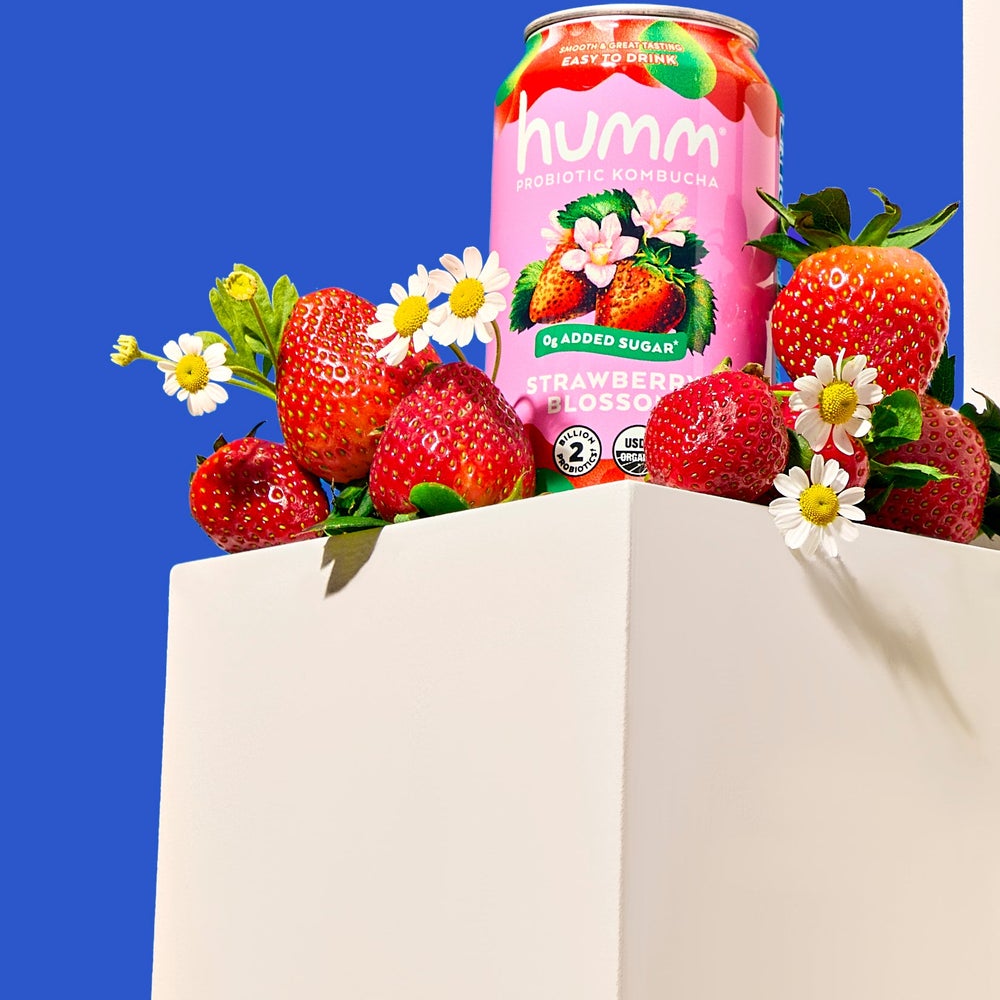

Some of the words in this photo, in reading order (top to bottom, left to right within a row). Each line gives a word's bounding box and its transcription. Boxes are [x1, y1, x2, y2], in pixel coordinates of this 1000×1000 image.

[559, 43, 597, 54] SMOOTH
[600, 42, 606, 50] &
[609, 41, 640, 49] GREAT
[642, 41, 684, 52] TASTING
[561, 54, 599, 67] EASY
[602, 53, 622, 62] TO
[626, 53, 678, 66] DRINK
[516, 169, 604, 192] PROBIOTIC
[612, 168, 718, 188] KOMBUCHA
[543, 334, 558, 348] 0g
[561, 333, 615, 346] ADDED
[547, 393, 661, 415] BLOSSO
[559, 430, 595, 446] BILLION
[625, 437, 645, 448] USD
[569, 441, 583, 462] 2
[620, 453, 645, 462] ORGA
